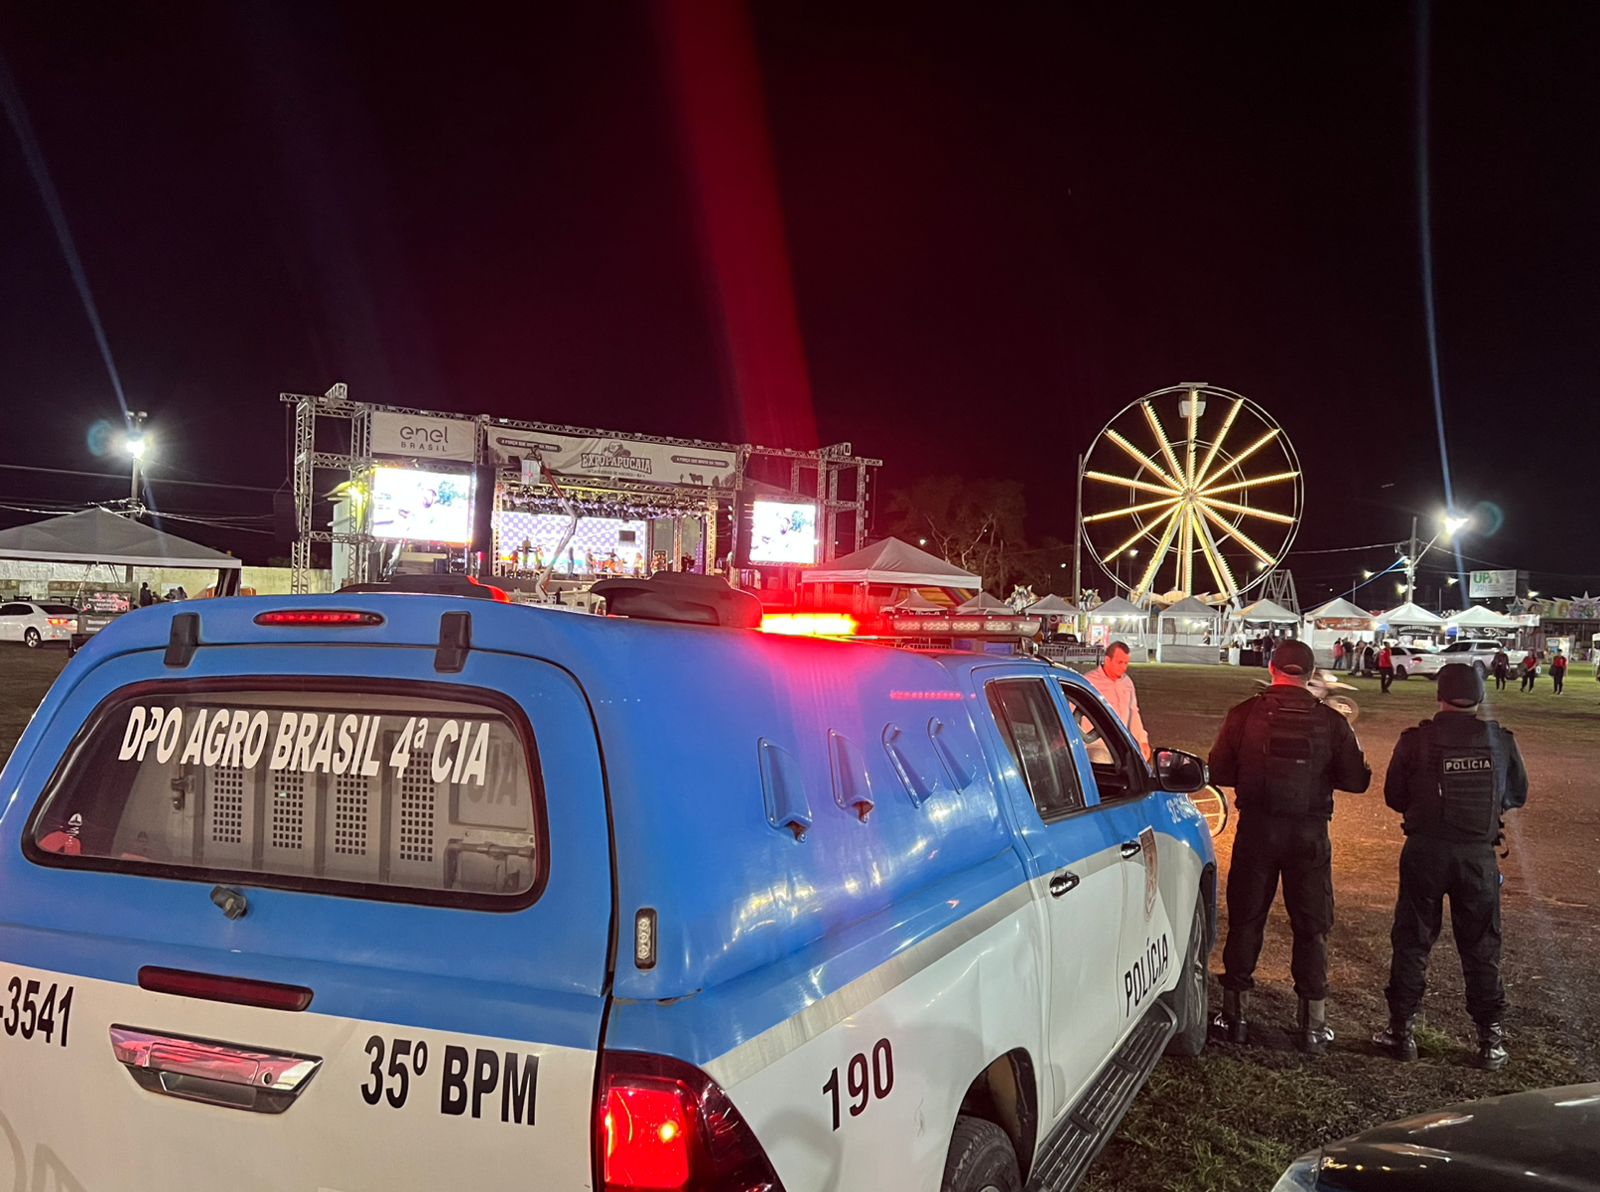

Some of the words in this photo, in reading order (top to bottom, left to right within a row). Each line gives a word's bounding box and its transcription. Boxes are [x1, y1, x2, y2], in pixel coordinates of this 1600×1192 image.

[400, 426, 448, 443] enel
[401, 441, 447, 452] BRASIL
[118, 706, 183, 763] DPO
[180, 709, 269, 770] AGRO
[269, 712, 382, 777] BRASIL
[389, 717, 429, 779] 4ª
[431, 719, 490, 786] CIA
[1124, 933, 1169, 1018] POLÍCIA
[360, 1035, 428, 1109] 35º
[441, 1045, 540, 1126] BPM
[822, 1037, 894, 1132] 190
